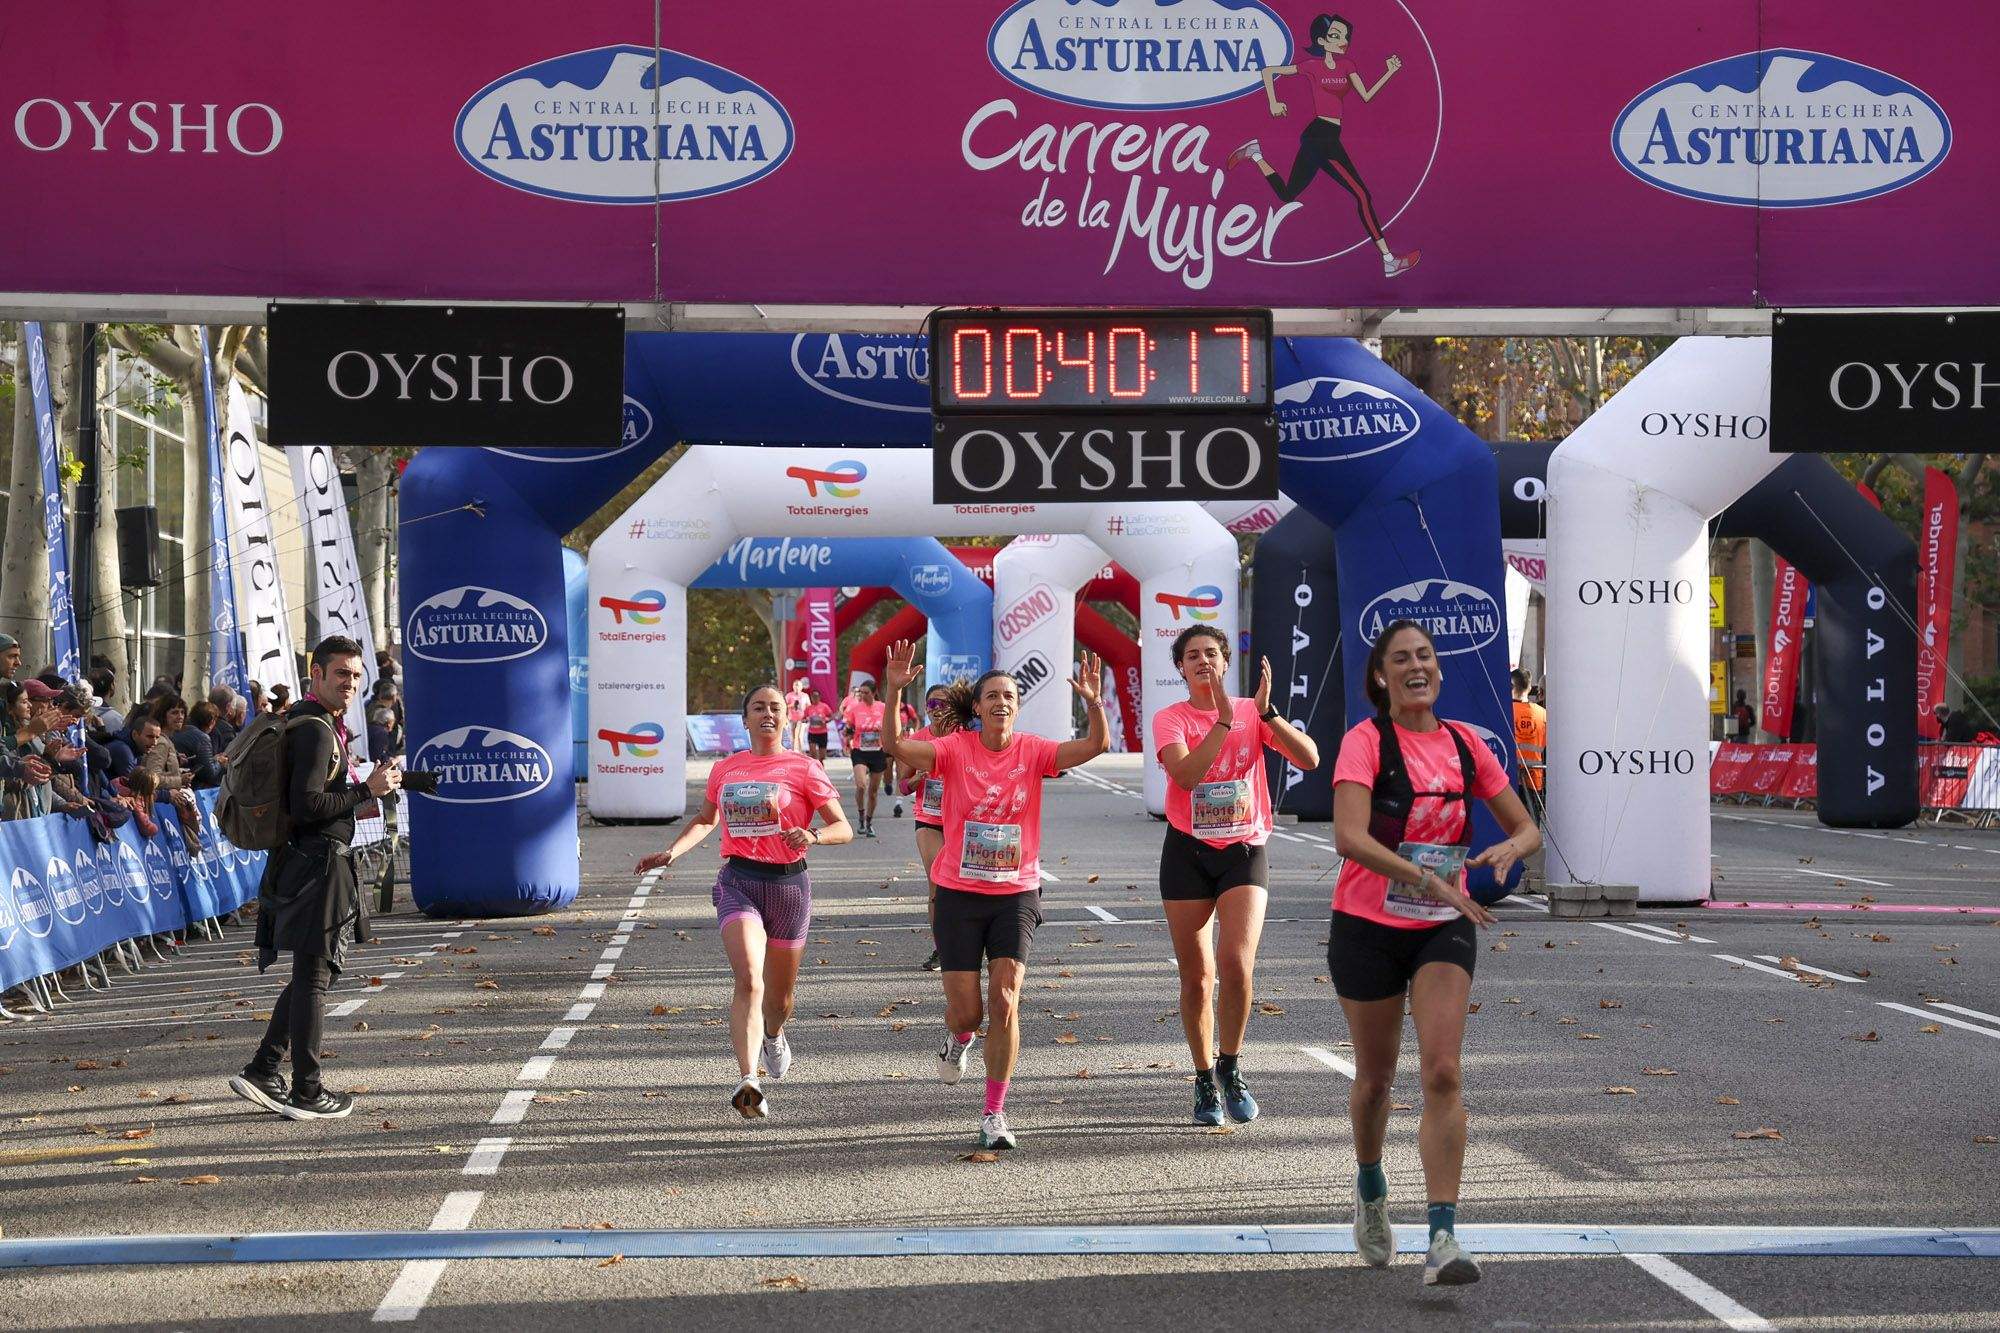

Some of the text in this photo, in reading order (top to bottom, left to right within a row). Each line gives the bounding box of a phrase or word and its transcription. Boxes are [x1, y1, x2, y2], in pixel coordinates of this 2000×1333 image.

[1059, 16, 1260, 30] CENTRAL LECHERA
[1011, 18, 1269, 73] ASTURIANA
[534, 99, 757, 116] CENTRAL LECHERA
[1692, 104, 1914, 118] CENTRAL LECHERA
[14, 98, 283, 155] OYSHO
[481, 103, 768, 162] ASTURIANA
[961, 99, 1209, 174] Carrera
[1638, 107, 1924, 165] ASTURIANA
[1021, 169, 1303, 289] de la Mujer
[814, 333, 929, 380] ASTU
[954, 328, 1250, 398] 00:40:17
[328, 351, 574, 404] OYSHO
[1829, 361, 2000, 411] OYSH
[1278, 401, 1398, 418] ENTRAL LECHERA
[1278, 413, 1409, 443] STURIANA
[1641, 412, 1767, 440] OYSHO
[951, 428, 1261, 492] OYSHO
[786, 506, 868, 517] TotalEnergies
[954, 503, 1035, 515] TotalEnergies
[716, 537, 832, 582] Marlene
[1578, 579, 1693, 606] OYSHO
[429, 612, 534, 622] CENTRAL LECHERA
[999, 590, 1054, 641] COSMO
[1389, 603, 1490, 616] CENTRAL LECHERA
[413, 618, 539, 648] ASTURIANA
[598, 631, 666, 643] TotalEnergies
[598, 681, 665, 691] totalenergies.es
[1867, 586, 1886, 796] VOLVO
[420, 756, 543, 786] ASTURIANA
[434, 750, 538, 762] CENTRAL LECHERA
[597, 764, 664, 775] TotalEnergies
[1578, 749, 1694, 776] OYSHO
